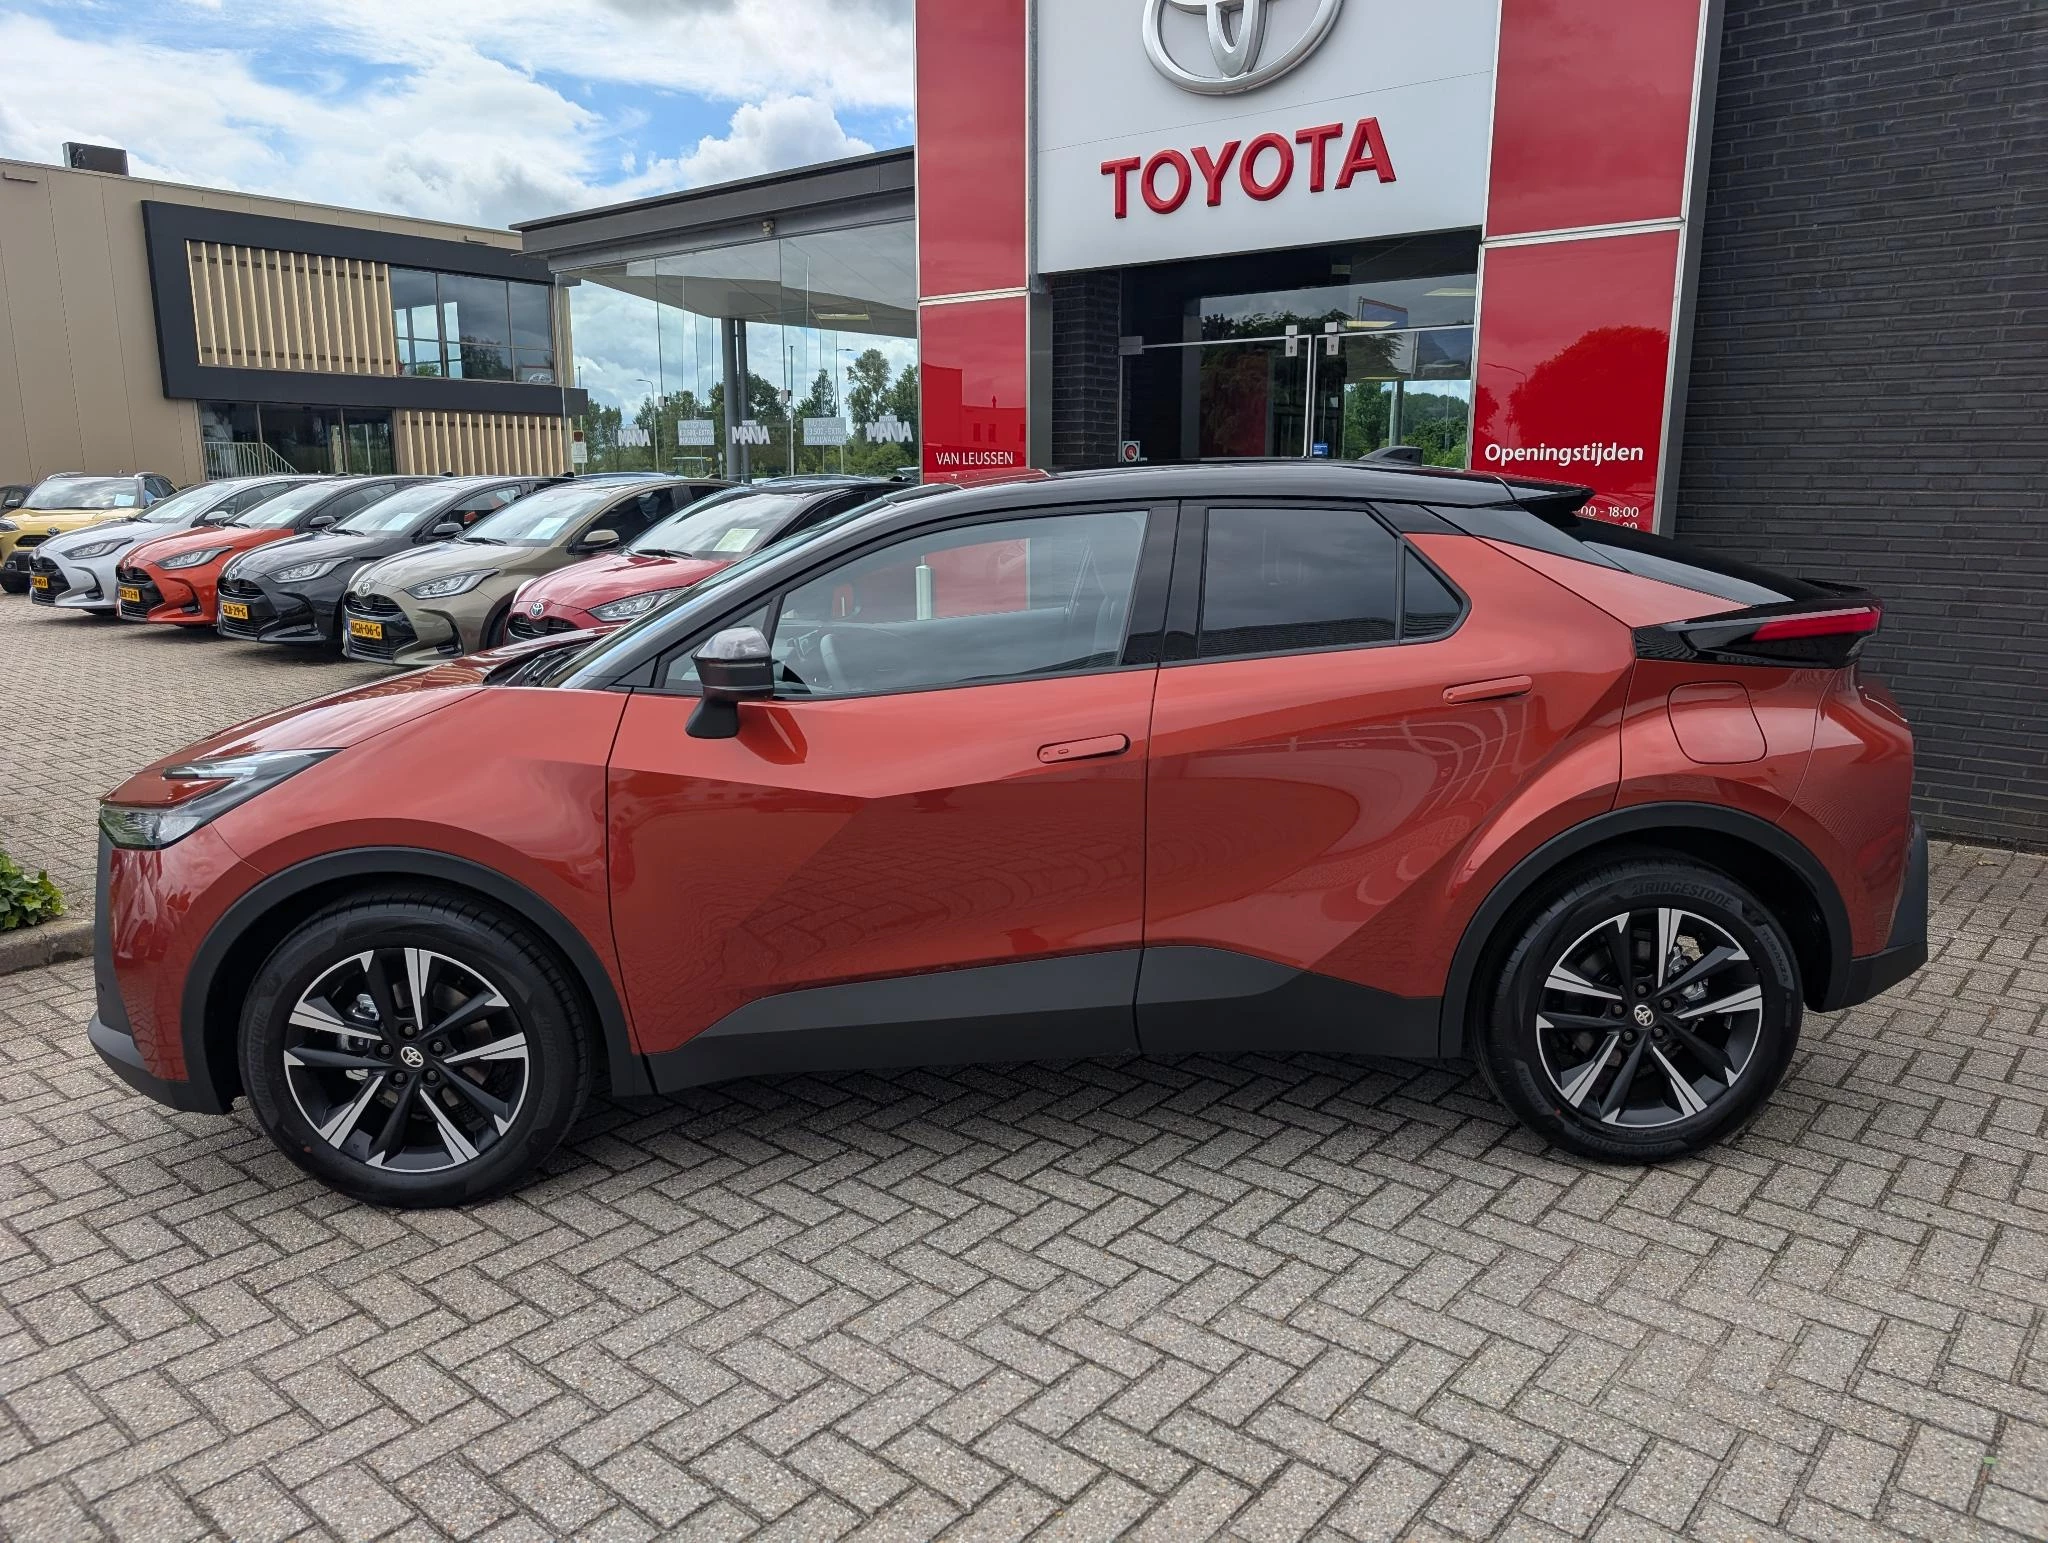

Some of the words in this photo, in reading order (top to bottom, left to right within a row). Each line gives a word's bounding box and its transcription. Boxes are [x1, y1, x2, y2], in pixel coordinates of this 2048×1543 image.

[1100, 116, 1396, 219] TOYOTA
[732, 425, 770, 445] MANIA
[866, 421, 913, 443] MANIA
[935, 452, 960, 465] VAN
[962, 451, 1013, 465] LEUSSEN
[1485, 442, 1643, 466] Openingstijden
[1608, 506, 1639, 517] 18:00
[1632, 879, 1734, 909] BRIDGESTONE
